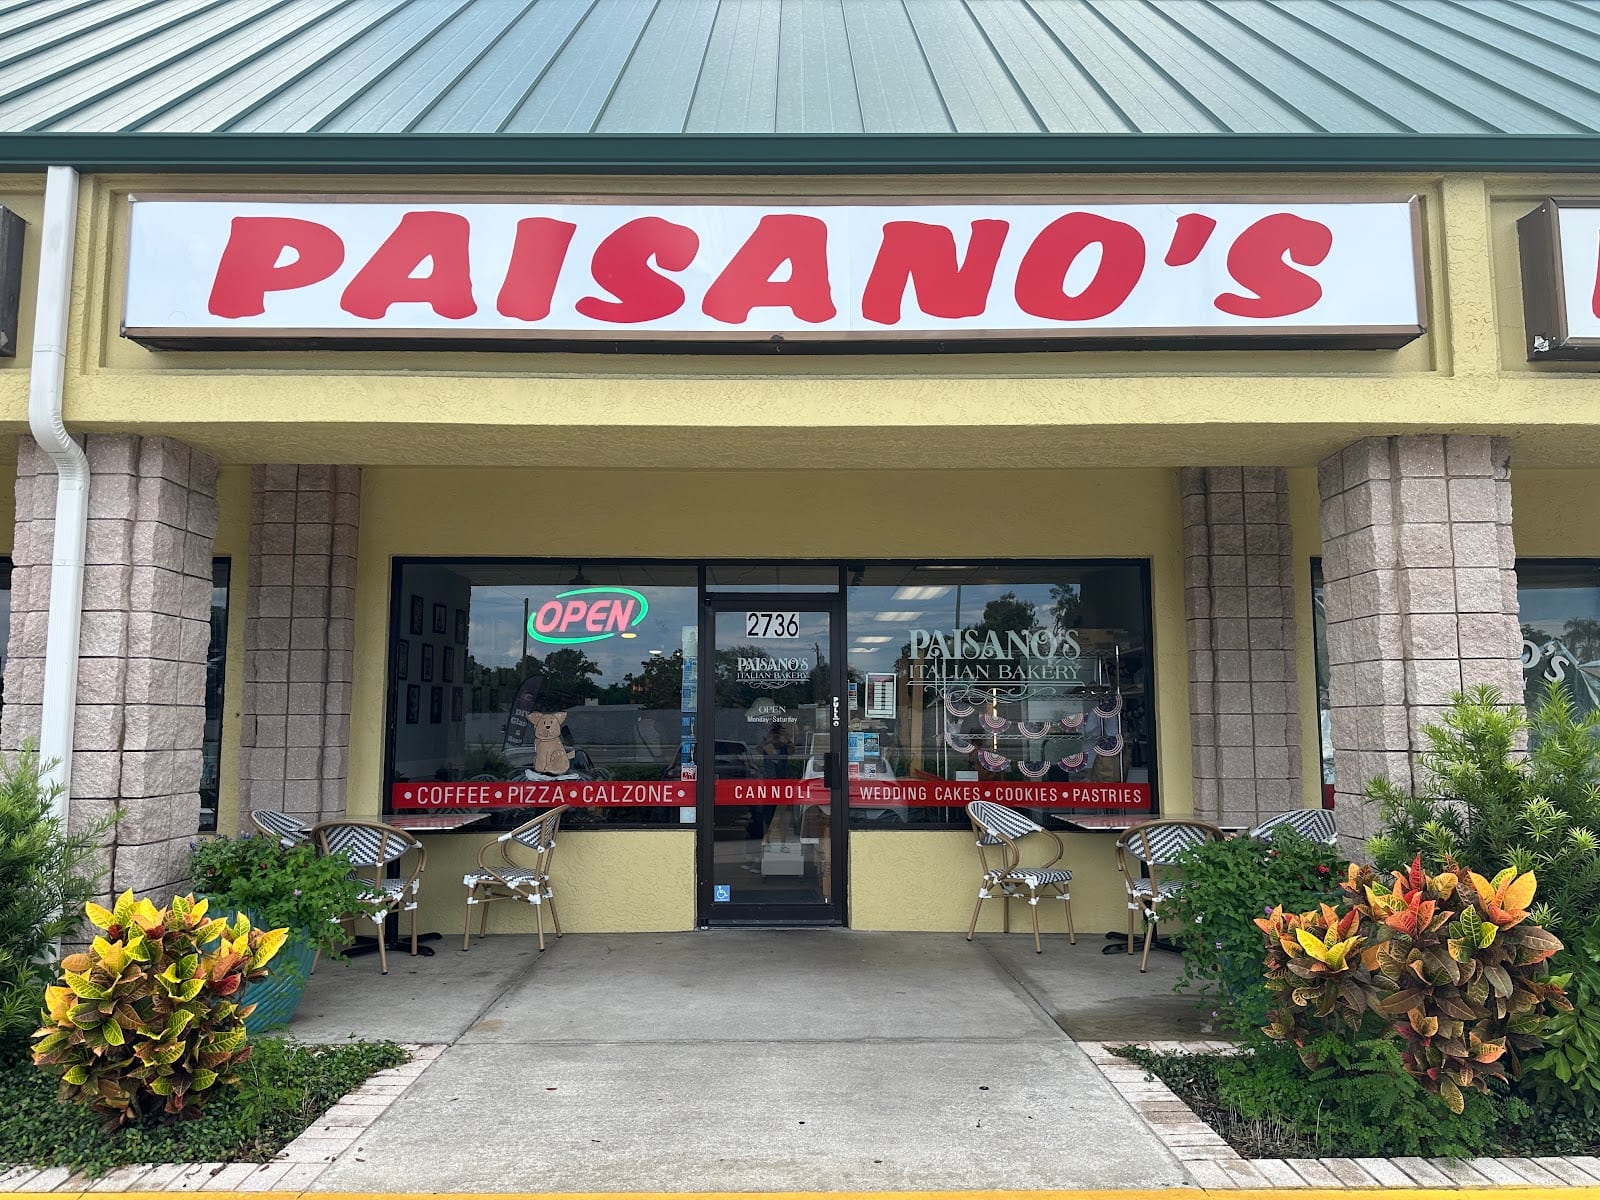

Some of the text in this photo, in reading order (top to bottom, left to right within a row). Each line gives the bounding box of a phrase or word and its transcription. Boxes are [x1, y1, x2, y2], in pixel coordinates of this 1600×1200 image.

[208, 211, 1333, 325] PAISANO'S
[535, 600, 636, 632] OPEN
[747, 612, 799, 637] 2736
[907, 628, 1082, 661] PAISANO'S
[736, 657, 809, 671] PAISANO'S
[909, 664, 1082, 680] ITALIAN BAKERY
[737, 671, 809, 679] ITALIAN BAKERY
[758, 705, 787, 714] OPEN
[417, 785, 674, 804] COFFEE PIZZA CALZONE
[734, 785, 811, 799] CANNOLI
[859, 786, 1142, 803] WEDDING CAKES COOKIES PASTRIES
